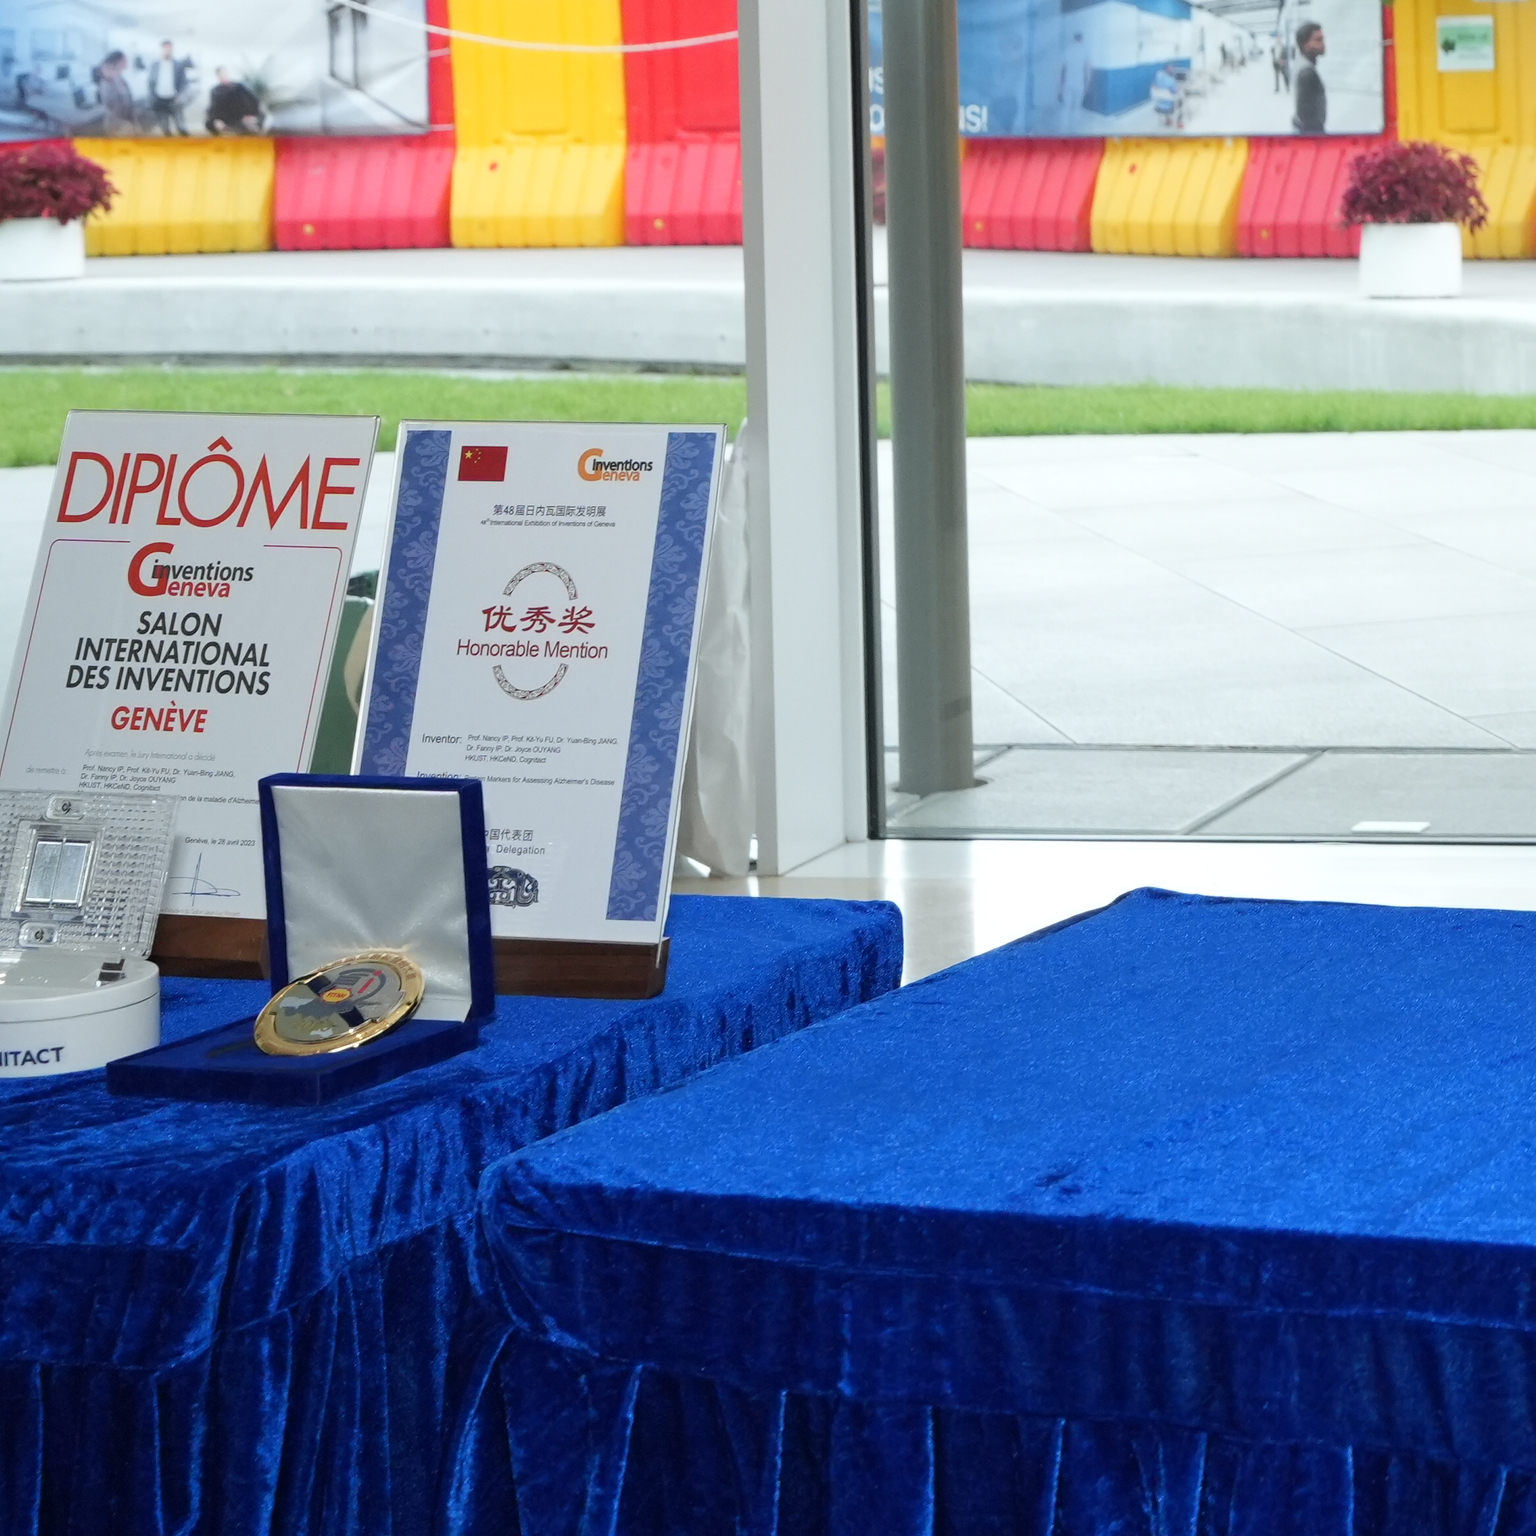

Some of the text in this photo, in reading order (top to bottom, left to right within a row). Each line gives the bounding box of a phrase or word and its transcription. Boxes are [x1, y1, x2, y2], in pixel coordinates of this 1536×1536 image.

[578, 448, 640, 481] Geneva
[592, 458, 653, 472] inventions
[57, 435, 361, 530] DIPLÔME
[493, 504, 606, 518] 第48届日内瓦国际发明展
[127, 541, 231, 598] Geneva
[151, 559, 254, 582] inventions
[137, 611, 222, 637] SALON
[482, 605, 596, 634] 优秀奖
[75, 637, 270, 667] INTERNATIONAL
[457, 639, 608, 659] Honorable Mention
[65, 664, 270, 696] DES INVENTIONS
[111, 700, 208, 733] GENÈVE
[421, 733, 462, 745] Inventor:
[496, 844, 545, 856] Delegation
[0, 1046, 64, 1067] ITACT
